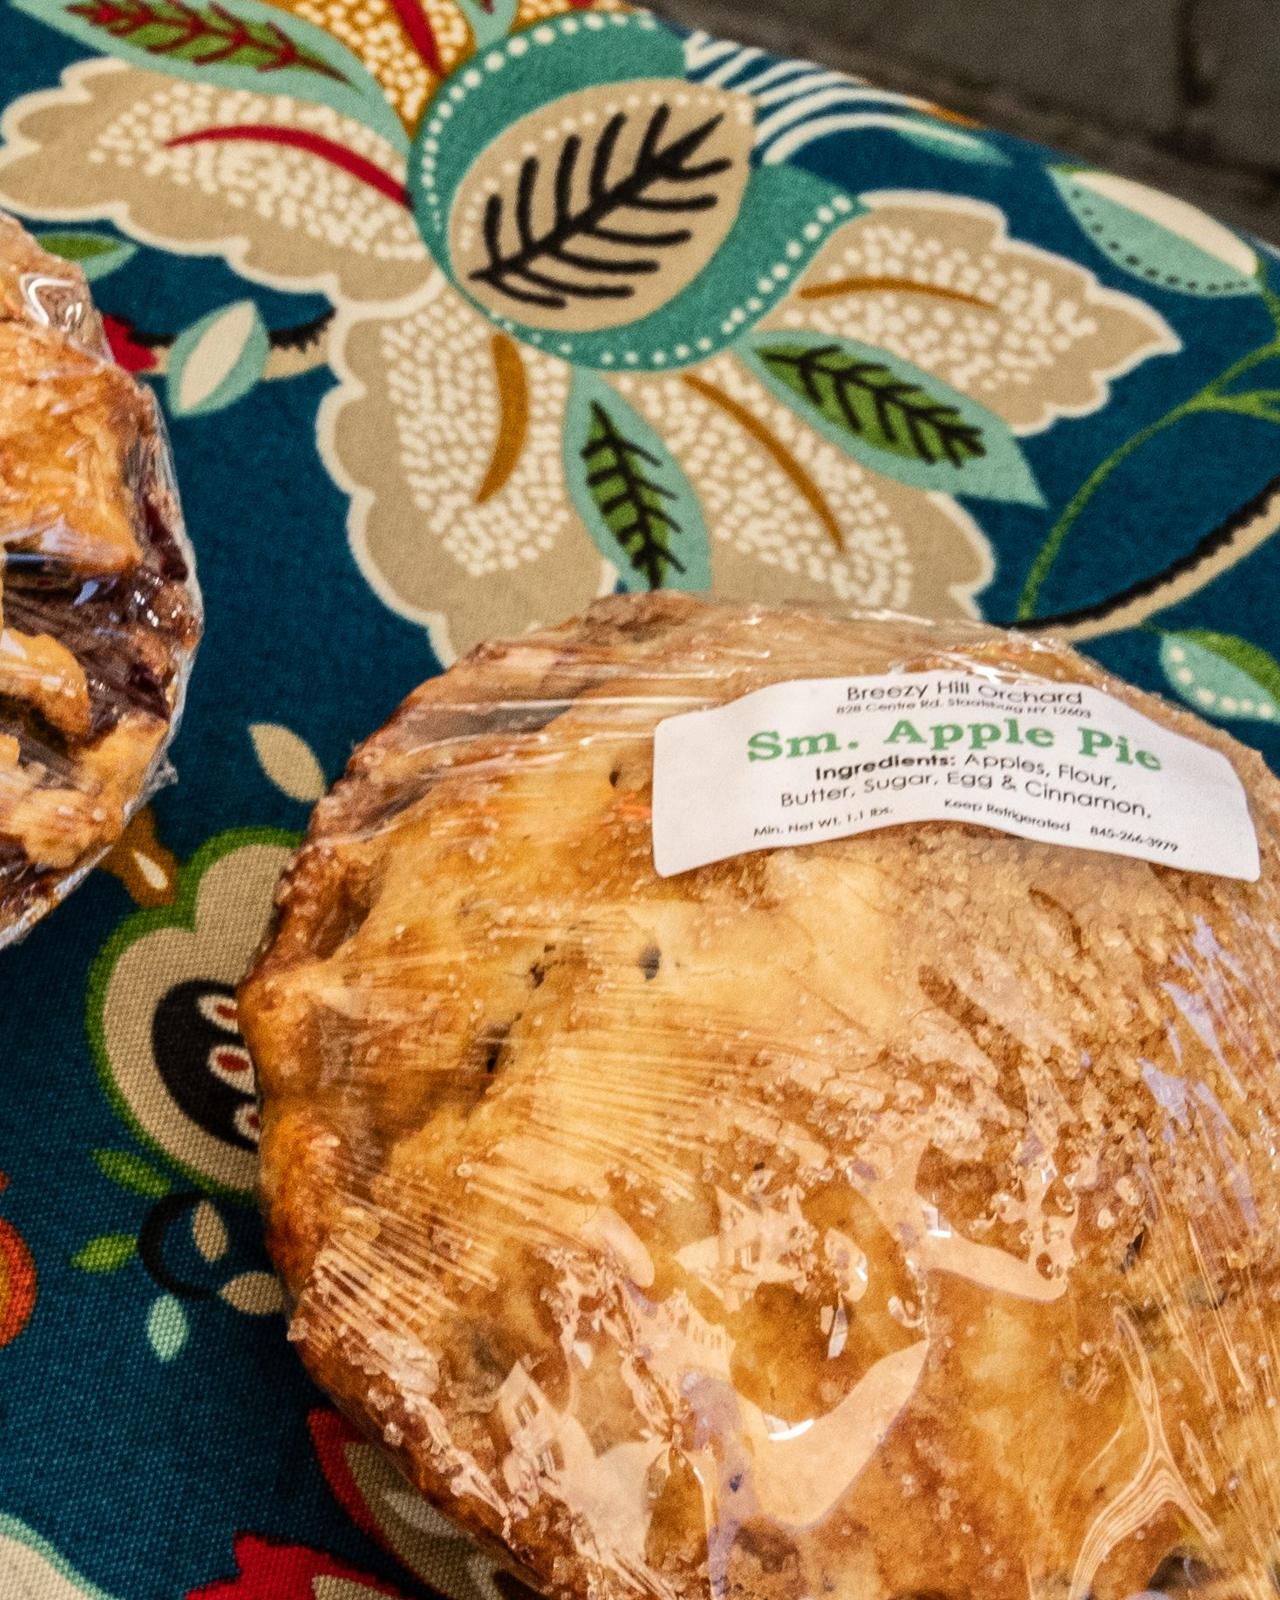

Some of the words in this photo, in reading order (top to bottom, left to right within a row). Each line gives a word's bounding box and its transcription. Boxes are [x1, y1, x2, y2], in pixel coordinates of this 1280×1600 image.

[847, 683, 930, 704] Breezy
[937, 680, 970, 695] Hill
[977, 684, 1083, 705] Orchard
[746, 727, 859, 763] Sm.
[883, 717, 1055, 750] Apple
[1078, 727, 1162, 770] Pie
[816, 755, 956, 780] Ingredients:
[965, 753, 1051, 778] Apples,
[1058, 763, 1117, 791] Flour,
[947, 772, 992, 790] Egg
[1000, 774, 1017, 791] &
[1024, 780, 1152, 819] Cinnamon.
